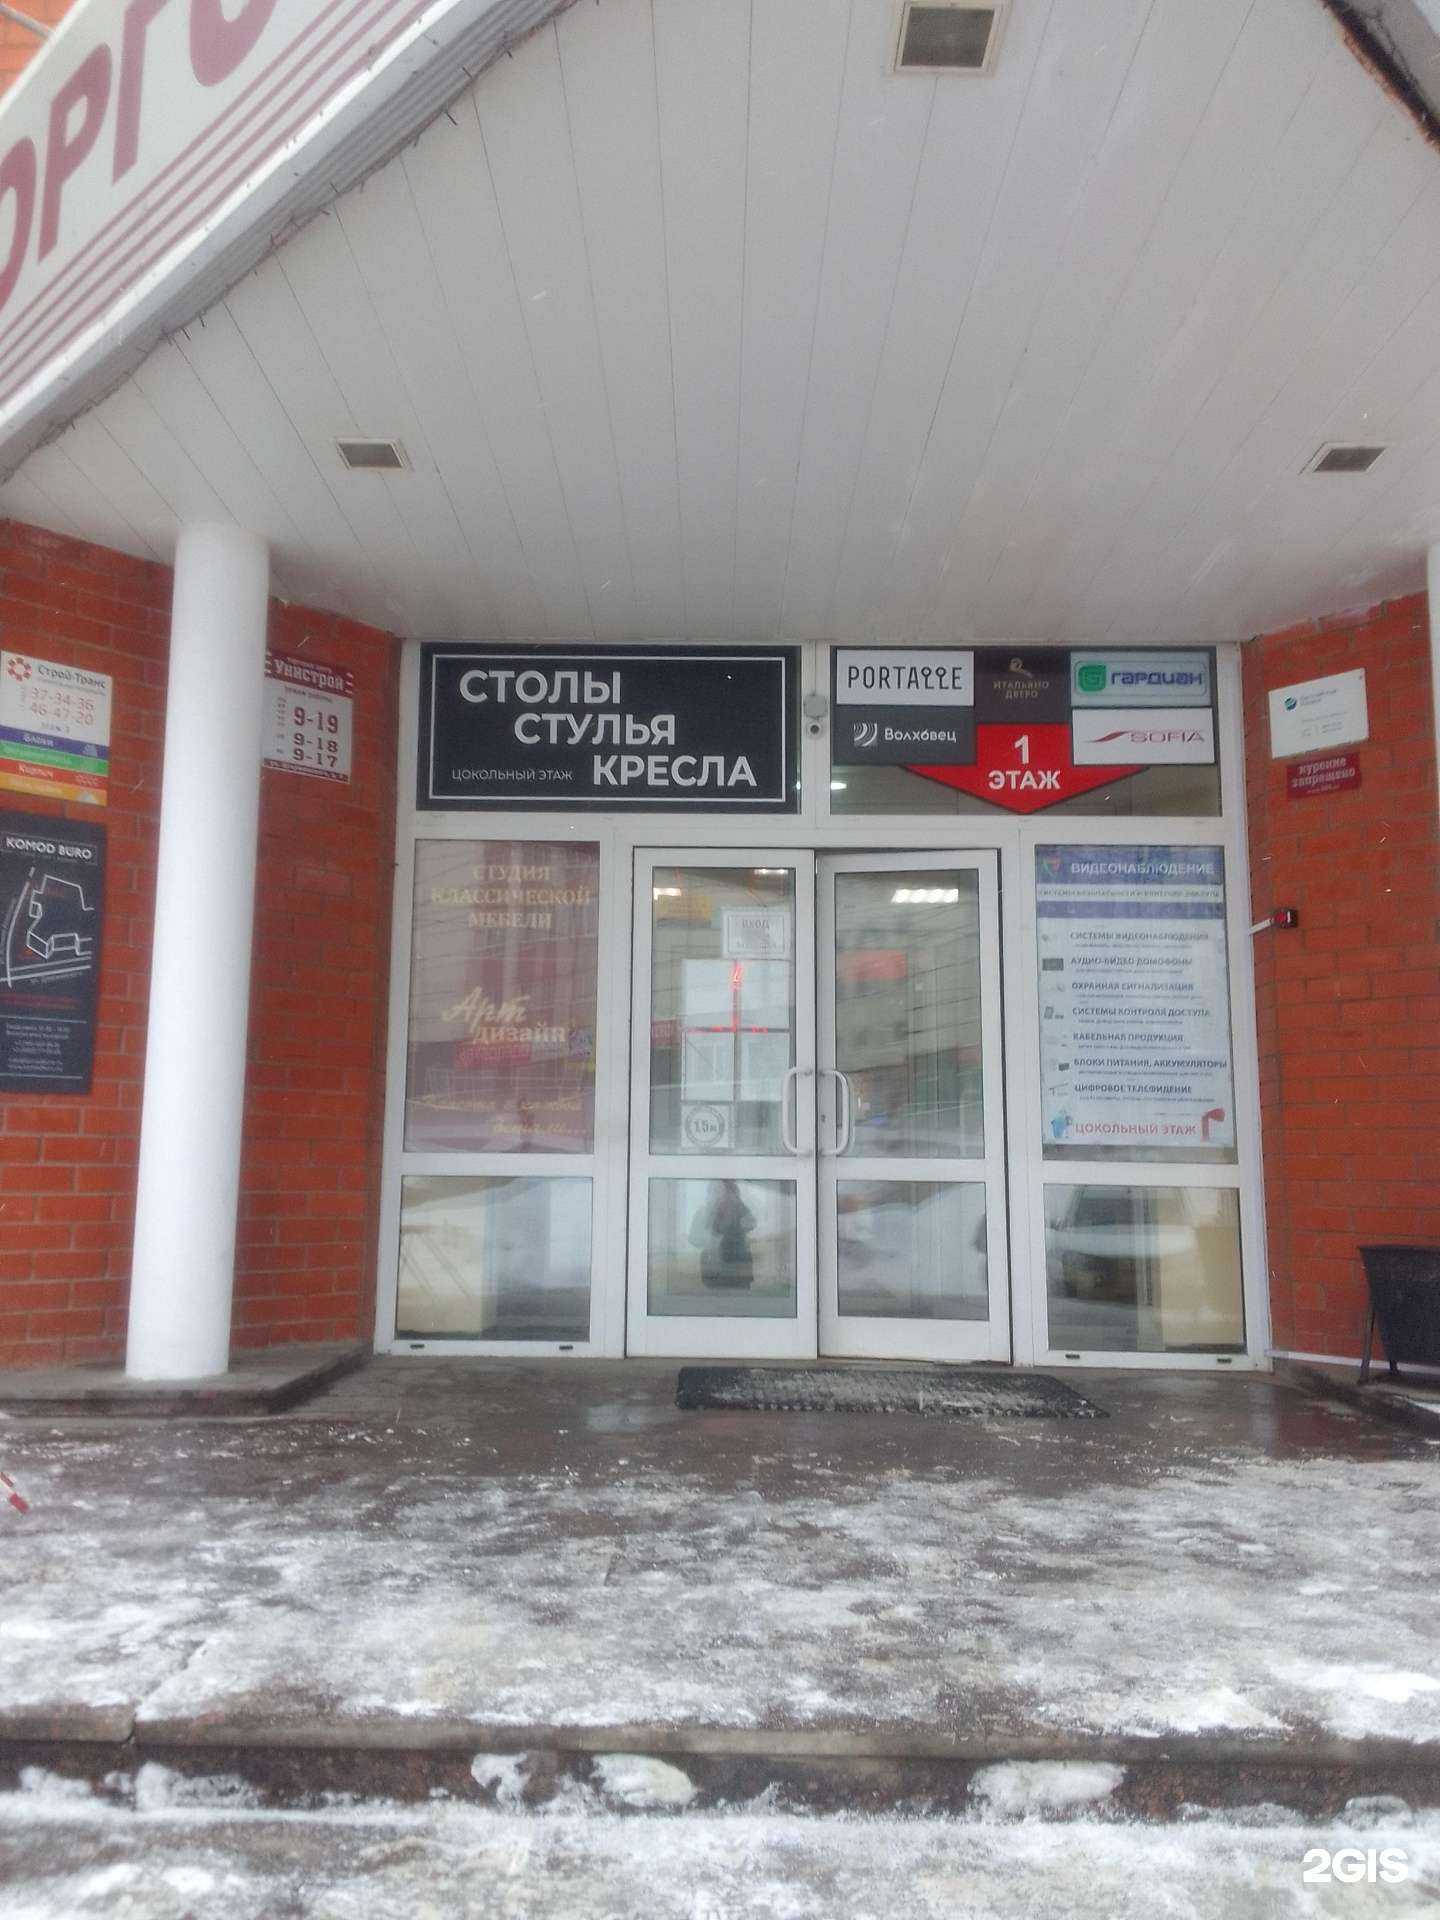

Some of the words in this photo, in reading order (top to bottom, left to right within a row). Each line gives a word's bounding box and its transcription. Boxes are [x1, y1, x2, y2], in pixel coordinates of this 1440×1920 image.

[459, 669, 621, 704] СТОЛЫ
[847, 664, 963, 690] PORTALLE
[514, 712, 676, 746] СТУЛЬЯ
[884, 727, 957, 743] Волховец
[1130, 730, 1205, 743] SOFIA
[1013, 735, 1030, 765] 1
[452, 767, 536, 782] ЦОКОЛЬНЫЙ
[538, 769, 573, 782] ЭТАЖ
[593, 754, 758, 787] КРЕСЛА
[987, 769, 1061, 791] ЭТАЖ
[1071, 862, 1216, 876] ВИДЕОНАБЛЮДЕНИЕ
[1075, 1121, 1159, 1135] ЦОКОЛЬНЫЙ
[1161, 1124, 1197, 1136] ЭТАЖ
